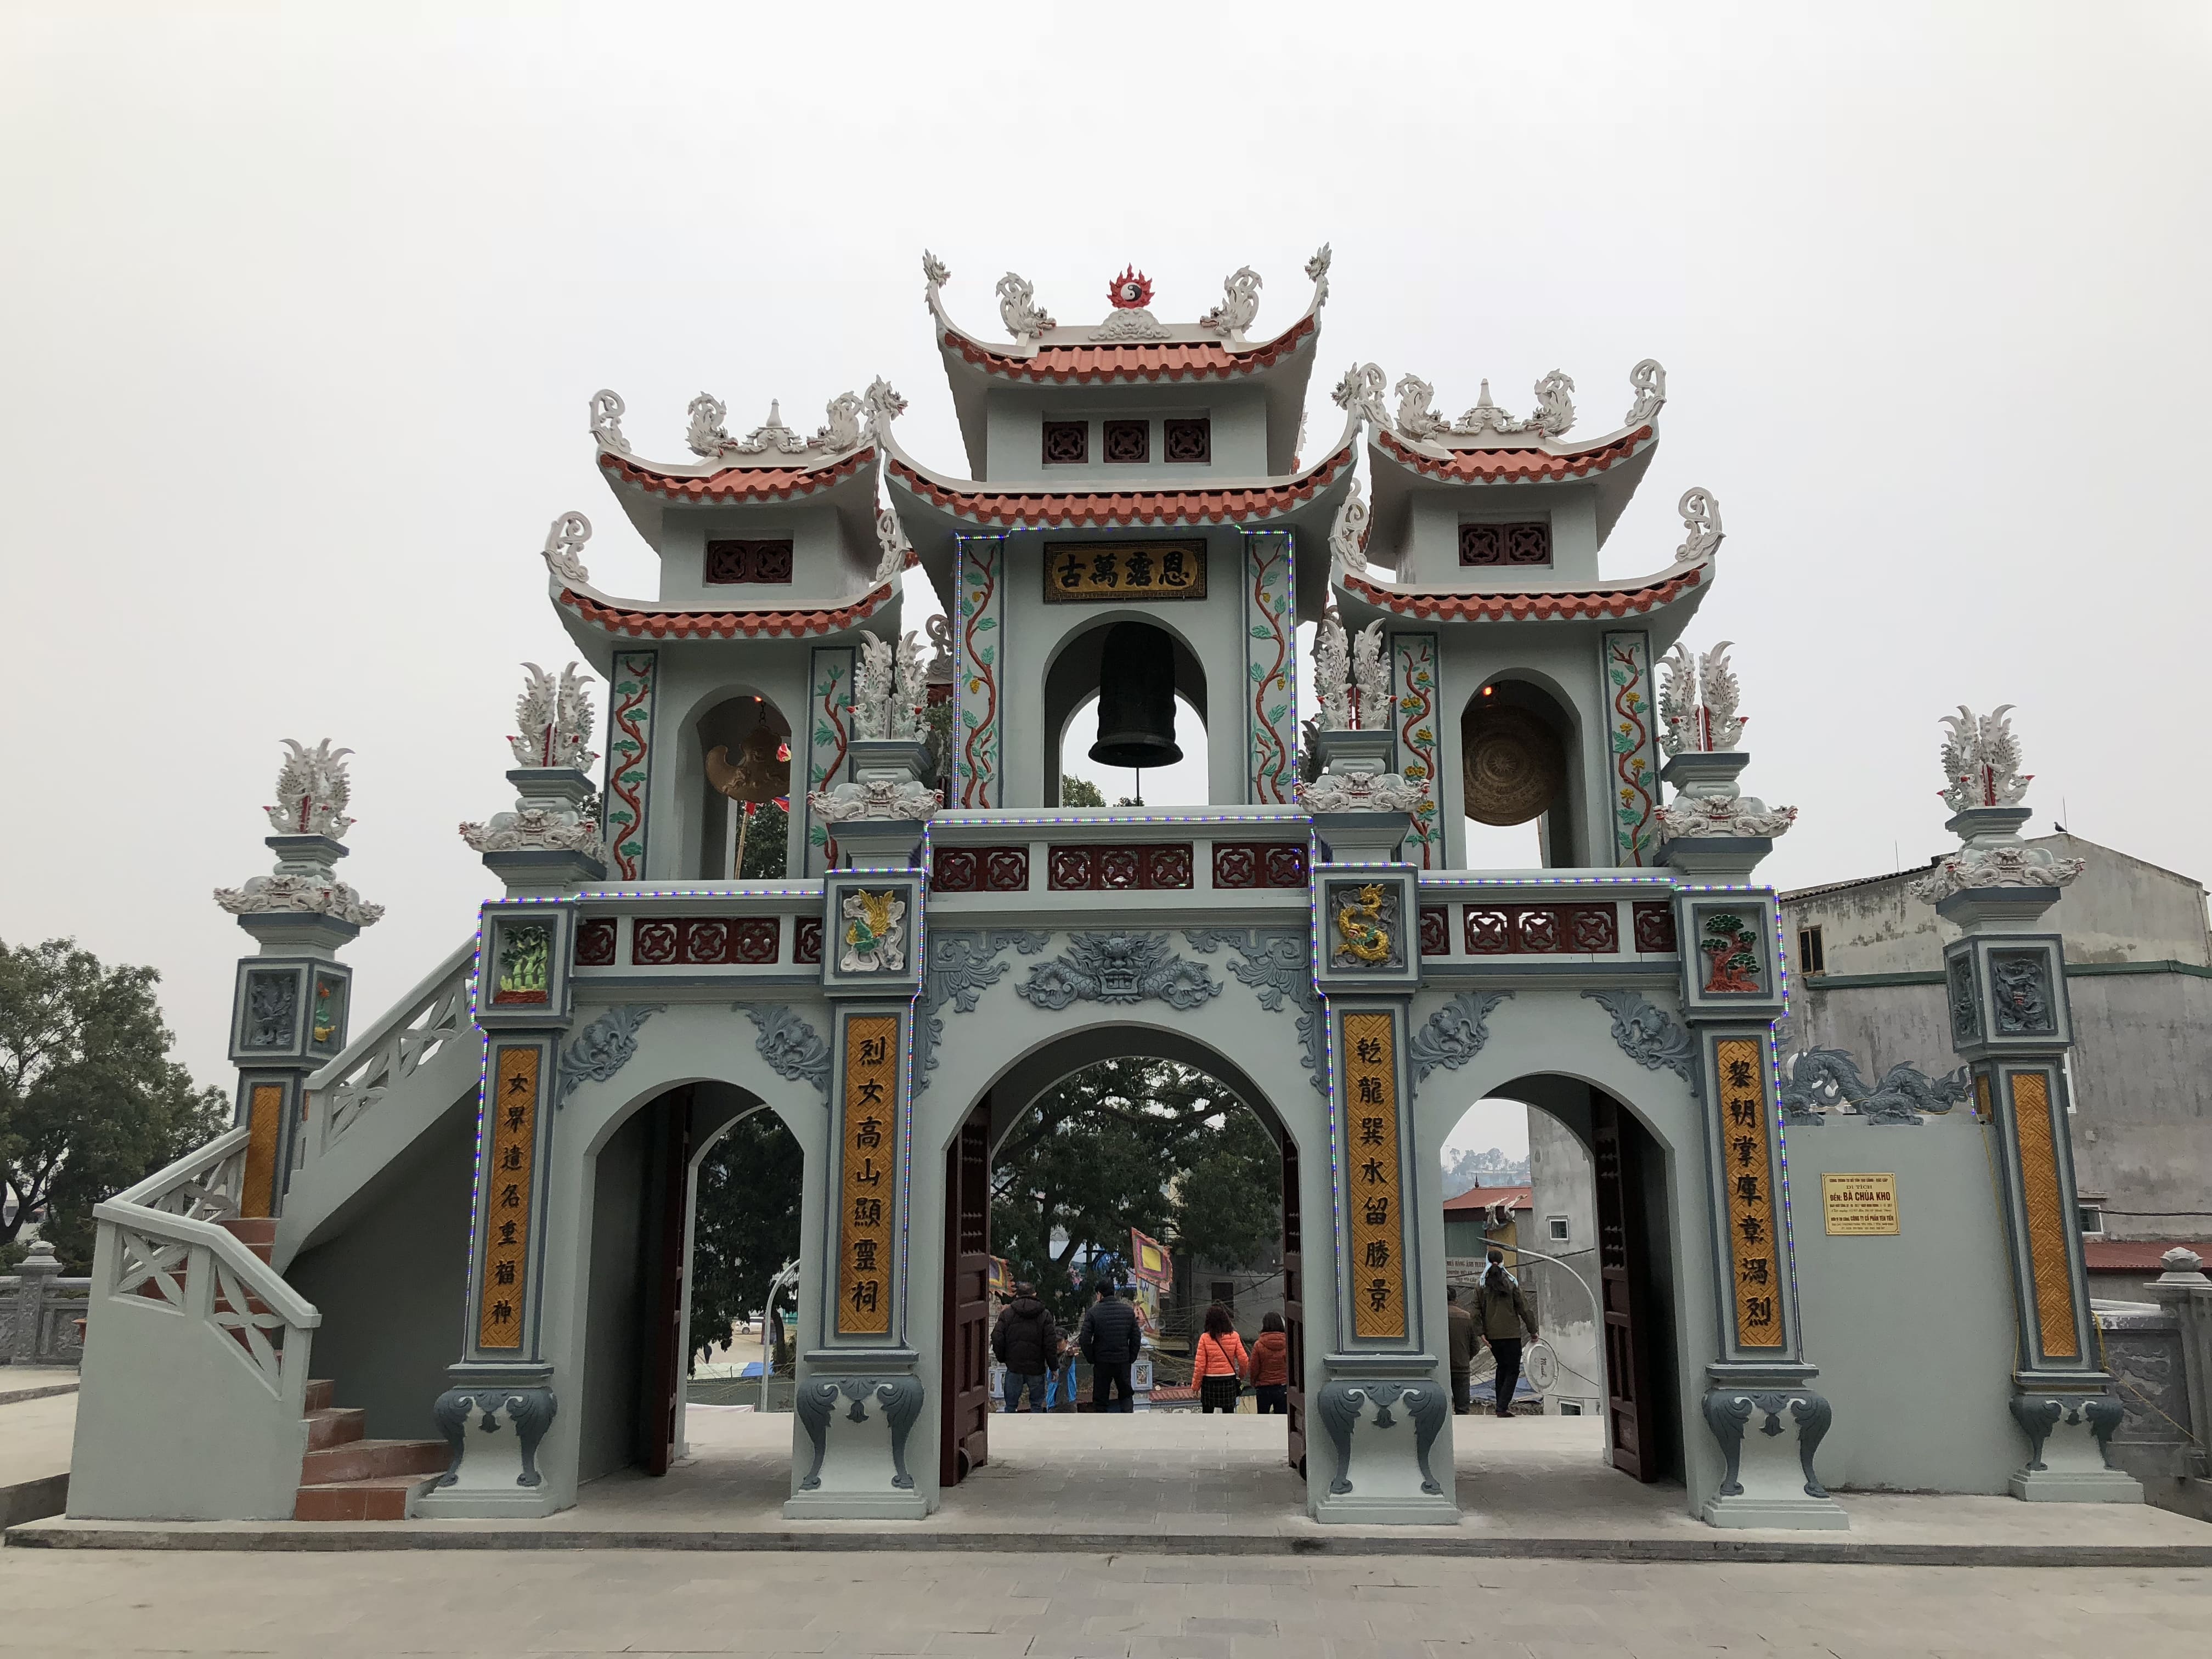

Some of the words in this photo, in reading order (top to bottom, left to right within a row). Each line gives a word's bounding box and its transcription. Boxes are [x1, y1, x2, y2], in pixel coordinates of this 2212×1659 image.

[1843, 1190, 1853, 1201] BÀ
[1855, 1190, 1875, 1201] CHÚA
[1876, 1192, 1891, 1201] KHO
